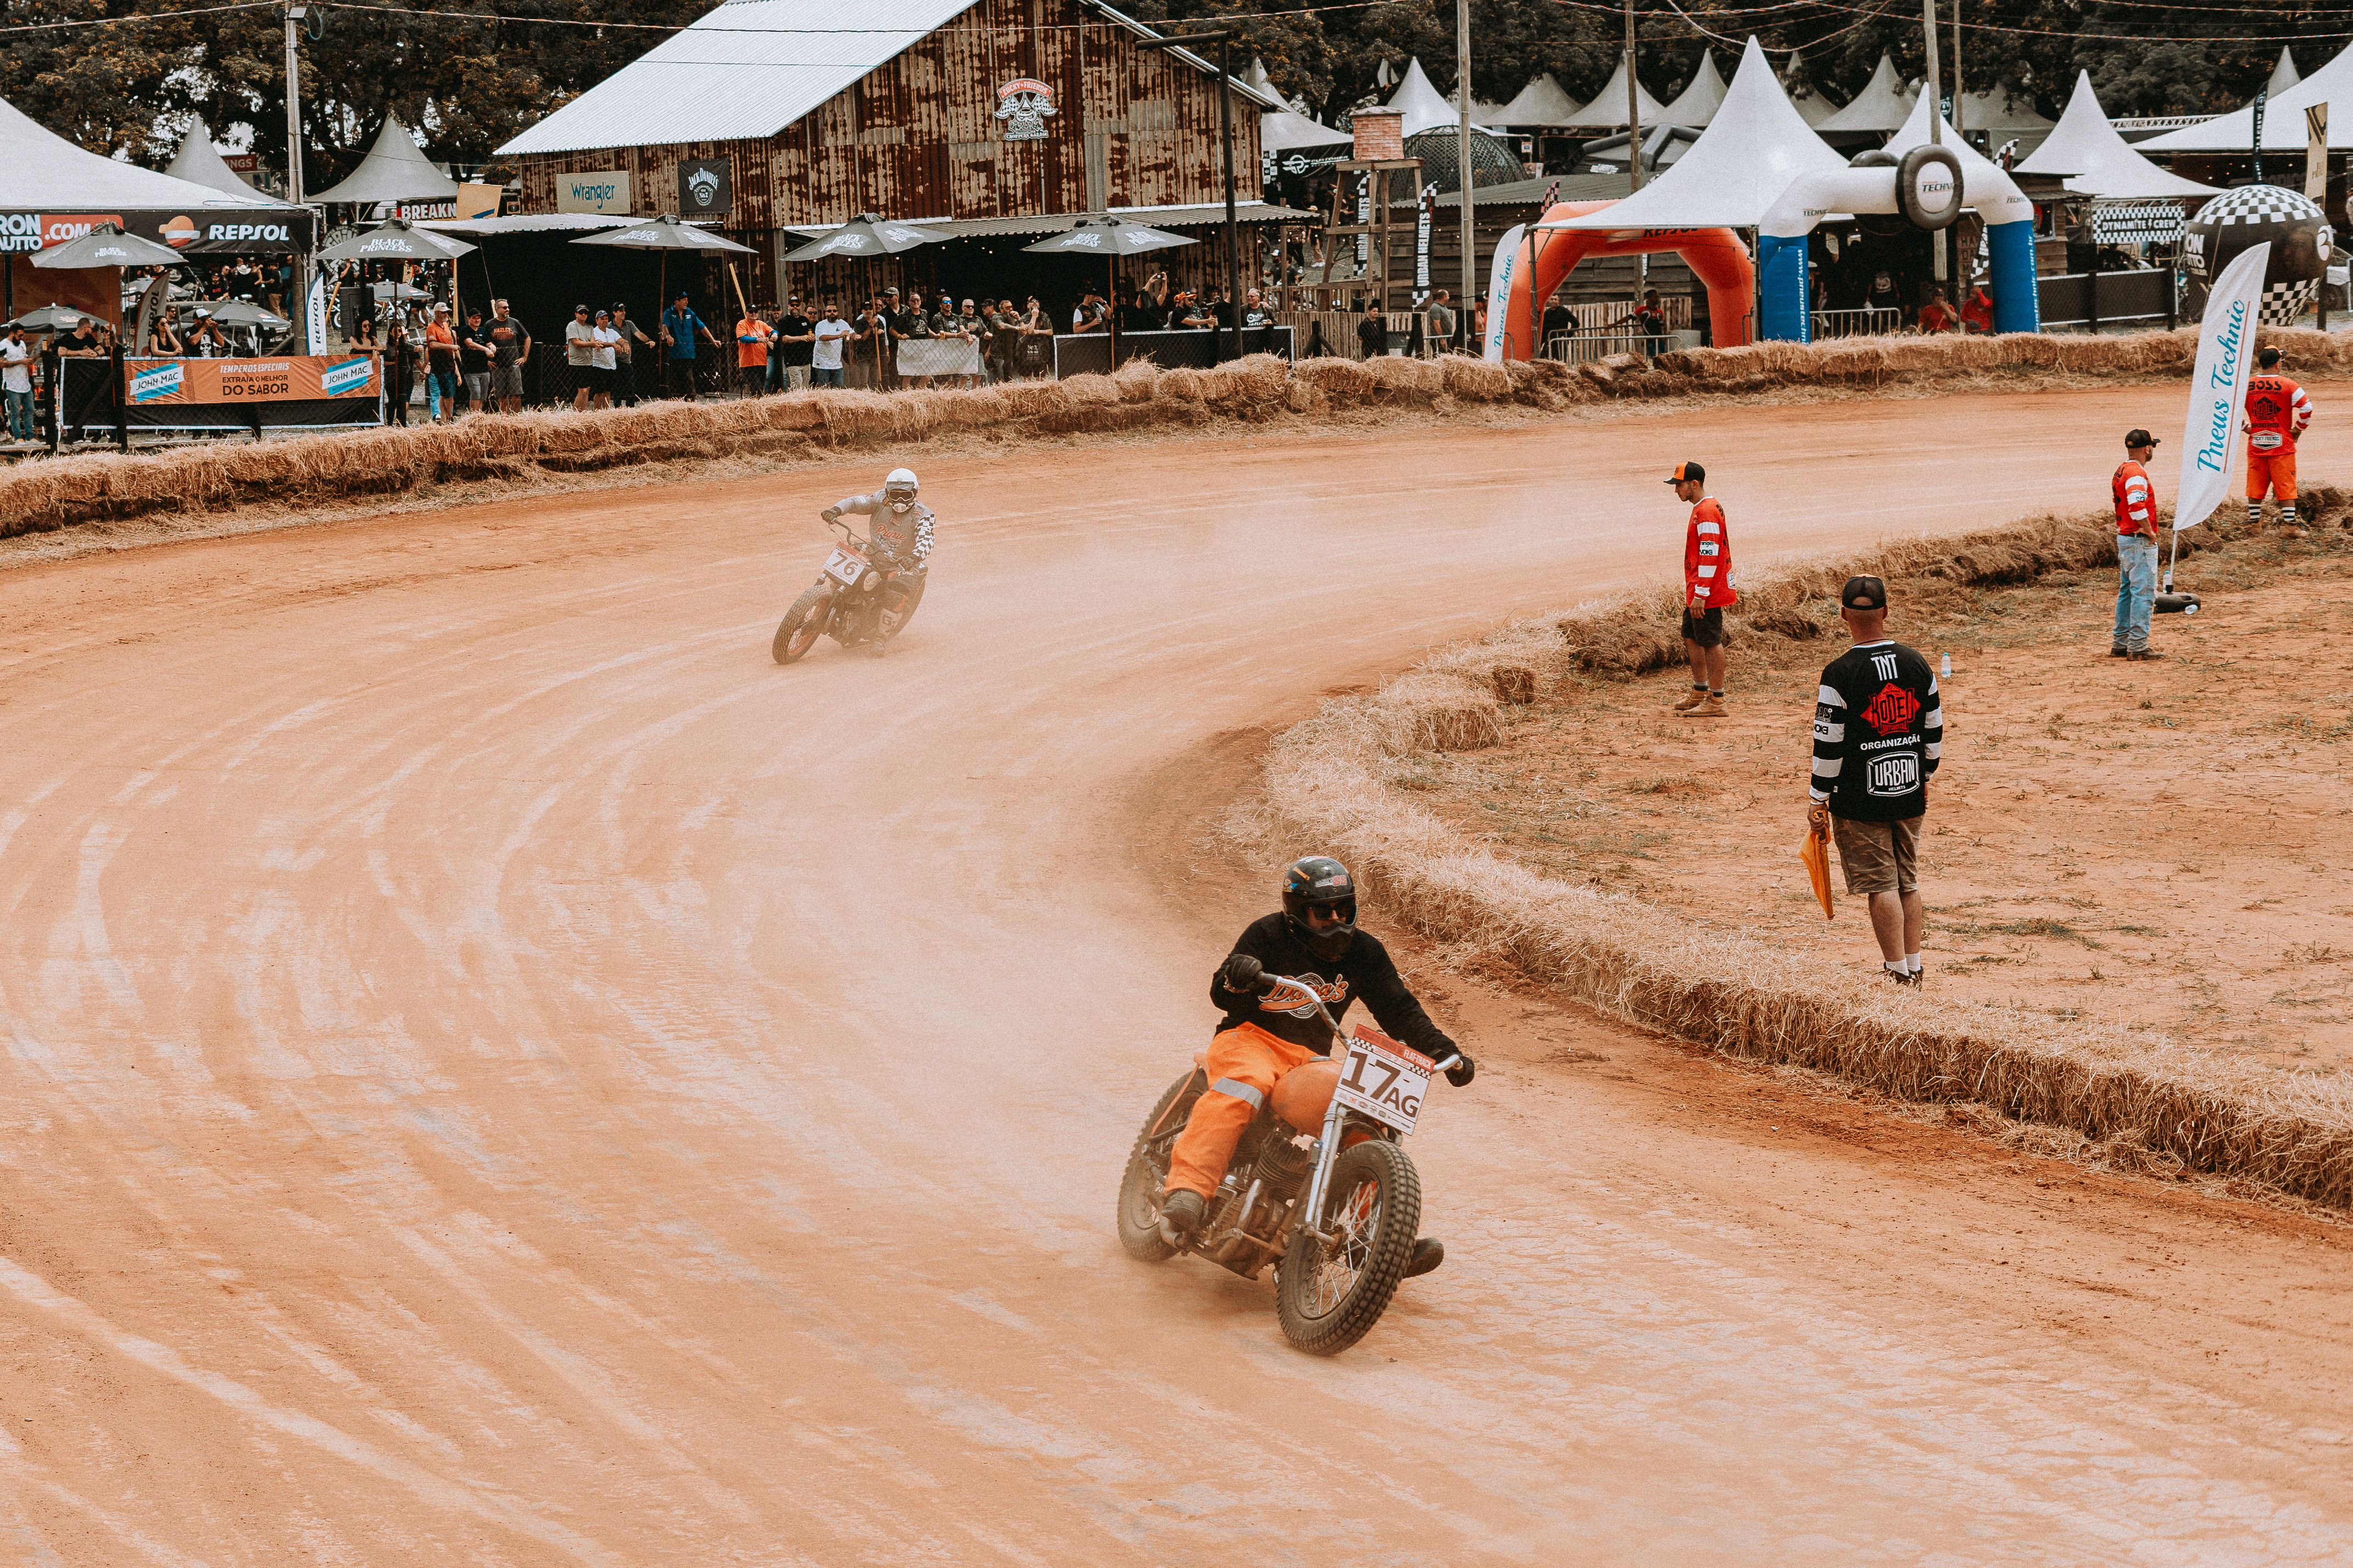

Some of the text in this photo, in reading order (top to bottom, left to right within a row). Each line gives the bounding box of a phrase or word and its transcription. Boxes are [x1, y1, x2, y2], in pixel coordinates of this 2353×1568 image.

[571, 181, 615, 209] Wrangler
[401, 203, 457, 220] BREAKN
[209, 225, 290, 241] REPSOL
[1418, 212, 1431, 254] HELMETS
[2102, 220, 2176, 231] DYNAMITE CREW
[359, 245, 413, 253] PRINCESS
[371, 238, 407, 247] BLACK
[1417, 255, 1429, 287] URBAN
[313, 295, 321, 344] REPSOL
[220, 362, 290, 373] TEMPEROS ESPECIAIS
[328, 366, 368, 384] JOHN MAC
[136, 378, 158, 390] JOHN
[161, 372, 178, 384] MAC
[222, 383, 289, 395] DO SABOR
[2197, 299, 2245, 472] Pneus Technic
[832, 552, 859, 576] 76
[1870, 654, 1898, 681] TNT
[1874, 759, 1915, 786] URBAN
